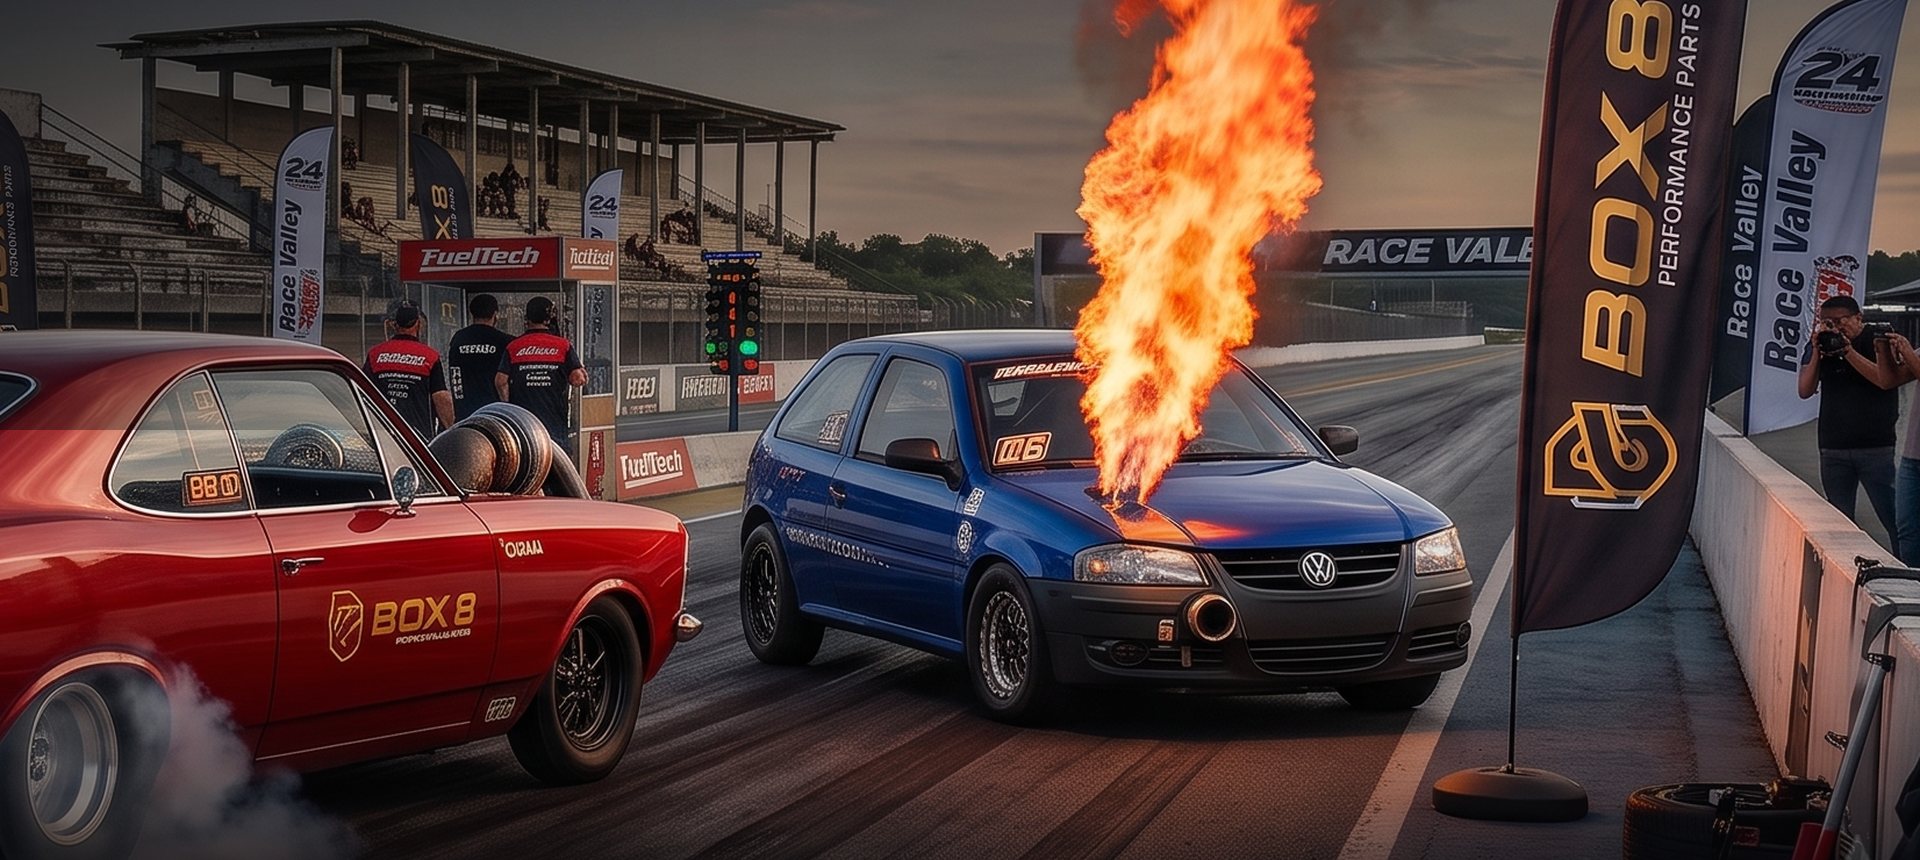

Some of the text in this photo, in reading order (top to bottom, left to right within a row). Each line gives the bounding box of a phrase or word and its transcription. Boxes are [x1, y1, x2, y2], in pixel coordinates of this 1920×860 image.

[1794, 51, 1881, 92] 24
[1658, 3, 1701, 287] PERFORMANCE PARTS
[285, 157, 324, 180] 24
[1582, 0, 1672, 378] BOX 8
[589, 194, 617, 211] 24
[279, 199, 302, 332] Race Valley
[420, 246, 541, 266] FuelTech
[1323, 237, 1434, 265] RACE
[1727, 164, 1763, 340] Race Valley
[1763, 129, 1827, 374] Race Valley
[371, 592, 477, 636] BOX 8
